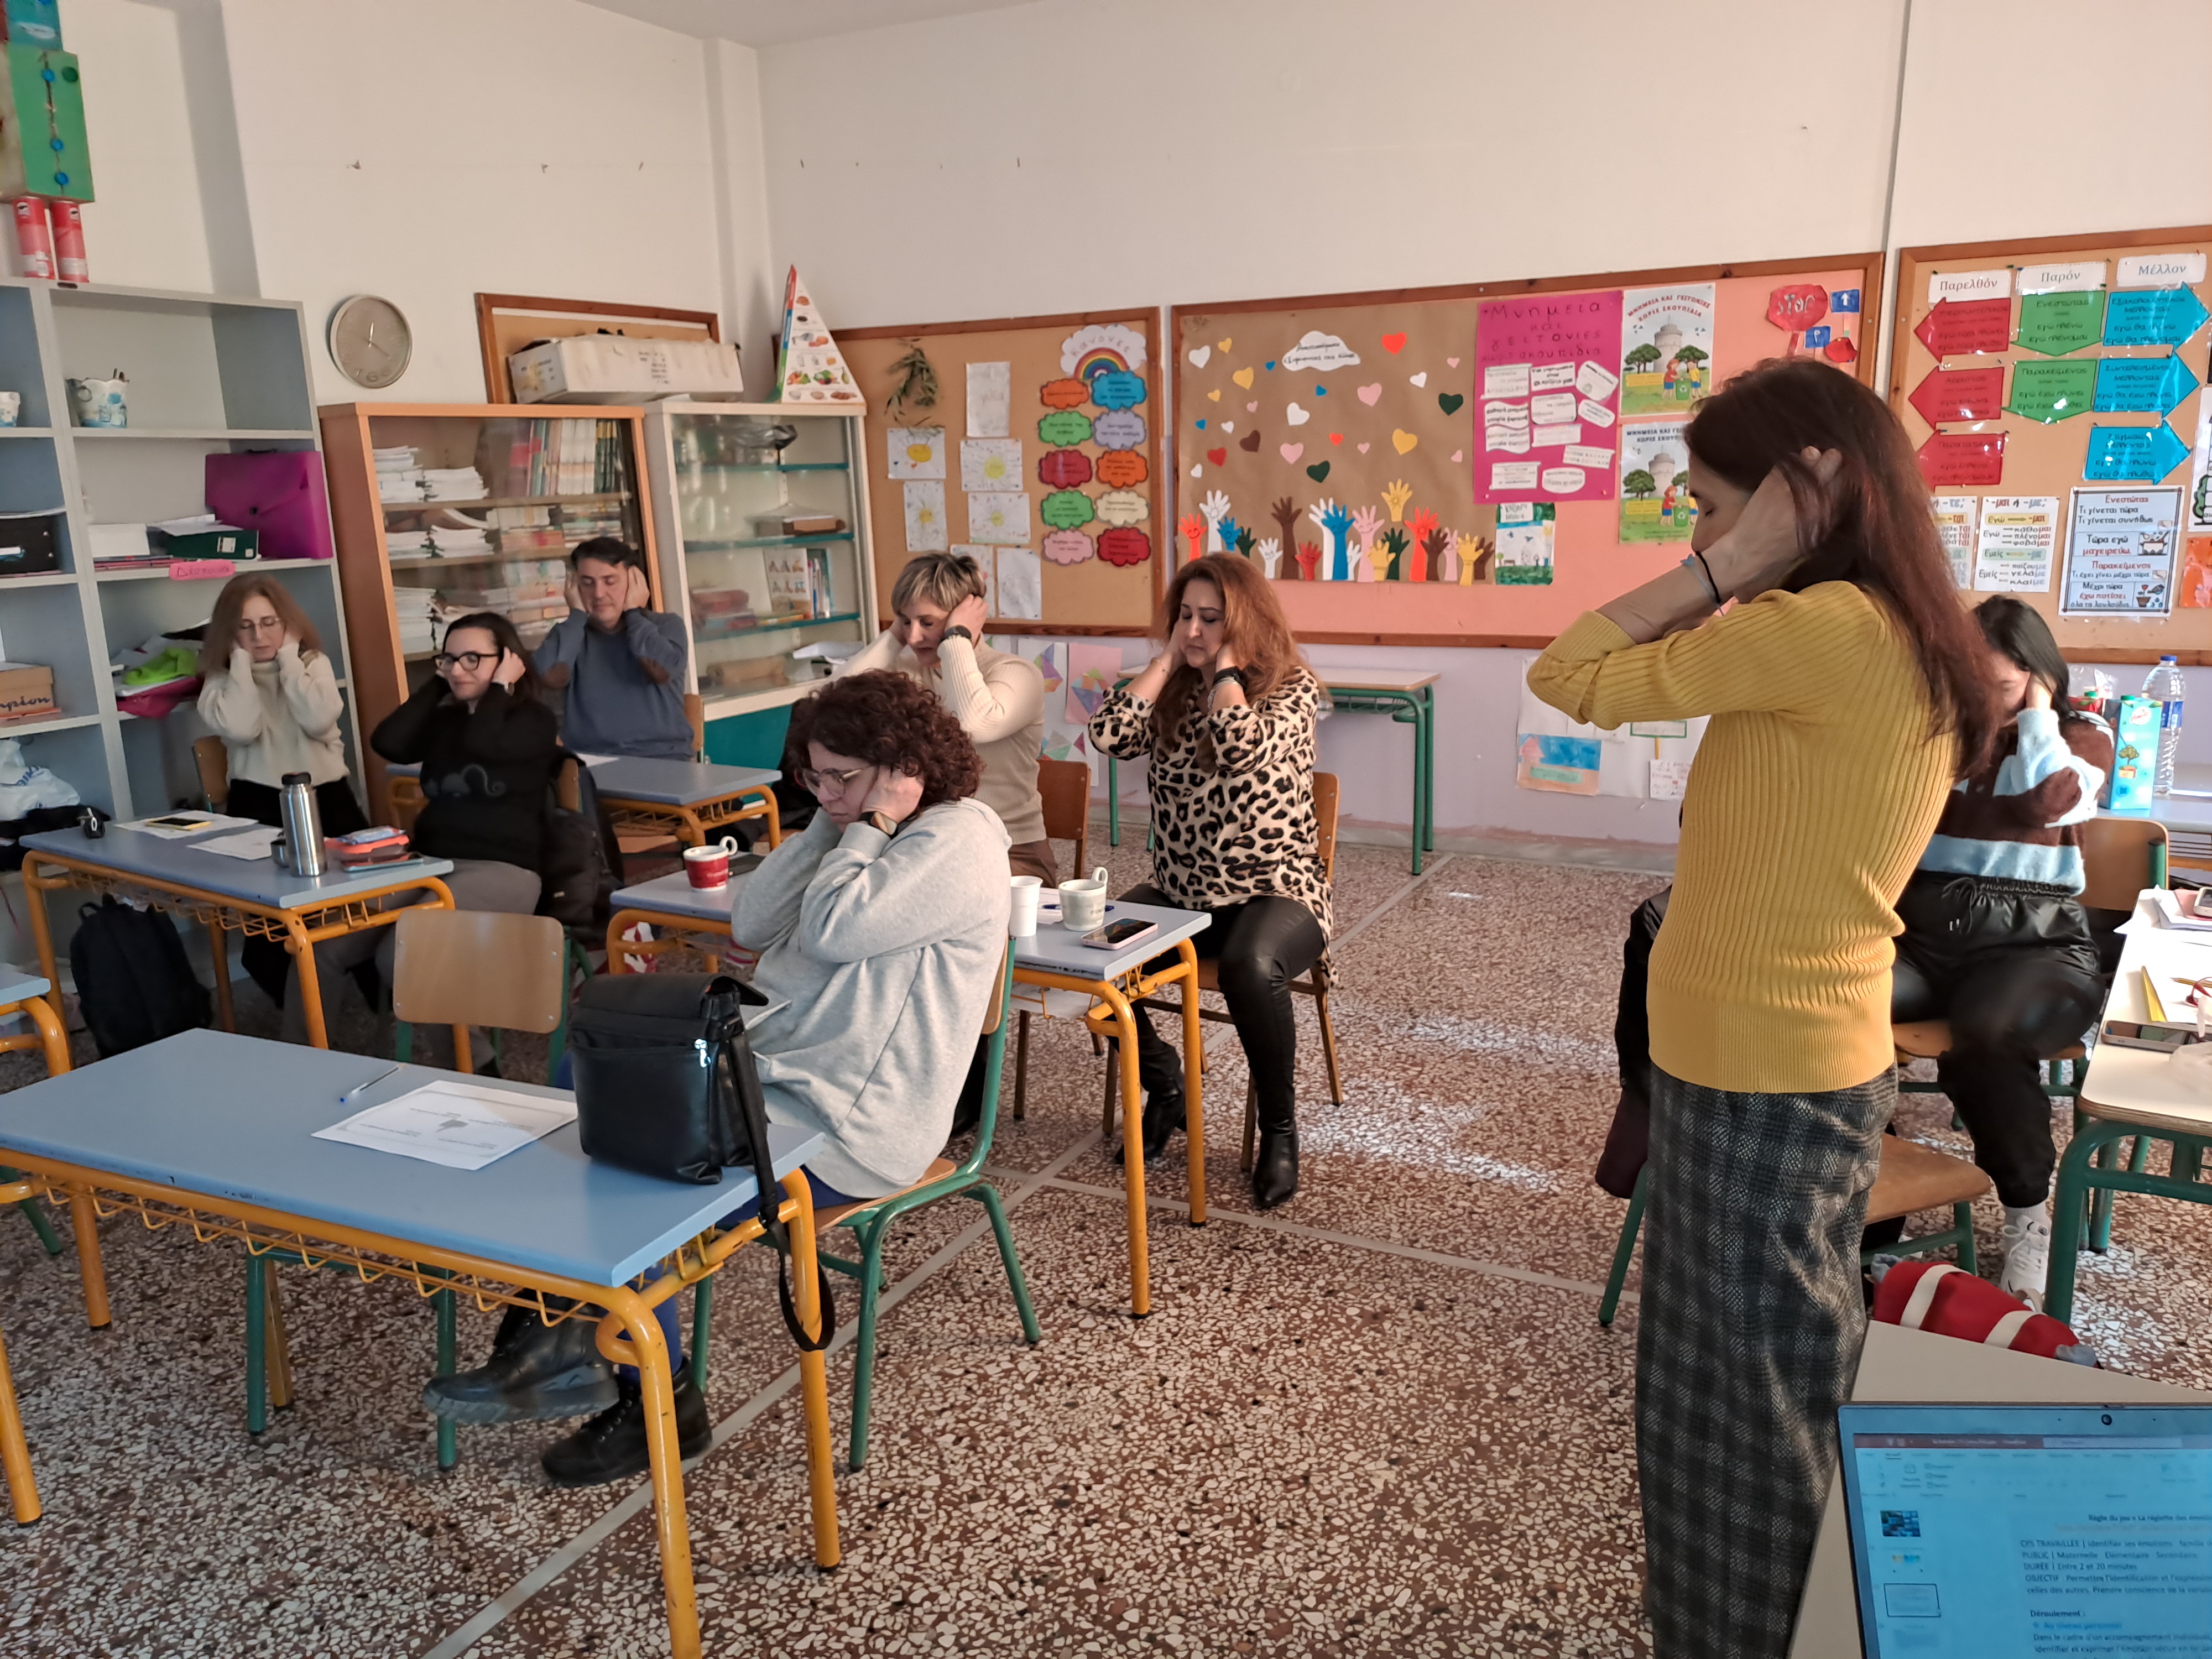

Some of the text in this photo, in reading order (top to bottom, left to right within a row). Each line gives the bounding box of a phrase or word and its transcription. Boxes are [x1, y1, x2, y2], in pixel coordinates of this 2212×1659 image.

[2138, 264, 2187, 275] Μέλλον
[2041, 270, 2080, 283] Παρόν
[1940, 278, 1997, 292] Παρελθόν
[2105, 495, 2149, 503] Ενεστώτας
[2079, 505, 2086, 514] Τι
[2089, 507, 2117, 515] γίνεται
[1987, 515, 2005, 524] Εγώ
[2078, 514, 2153, 525] Τι γίνεται συνήθως
[2087, 534, 2128, 545] Τώρα εγώ
[1984, 549, 2003, 559] Εμείς
[2092, 561, 2151, 570] Παρακείμενος
[1979, 569, 1997, 580] Εμείς
[2083, 581, 2104, 590] Μέχρι
